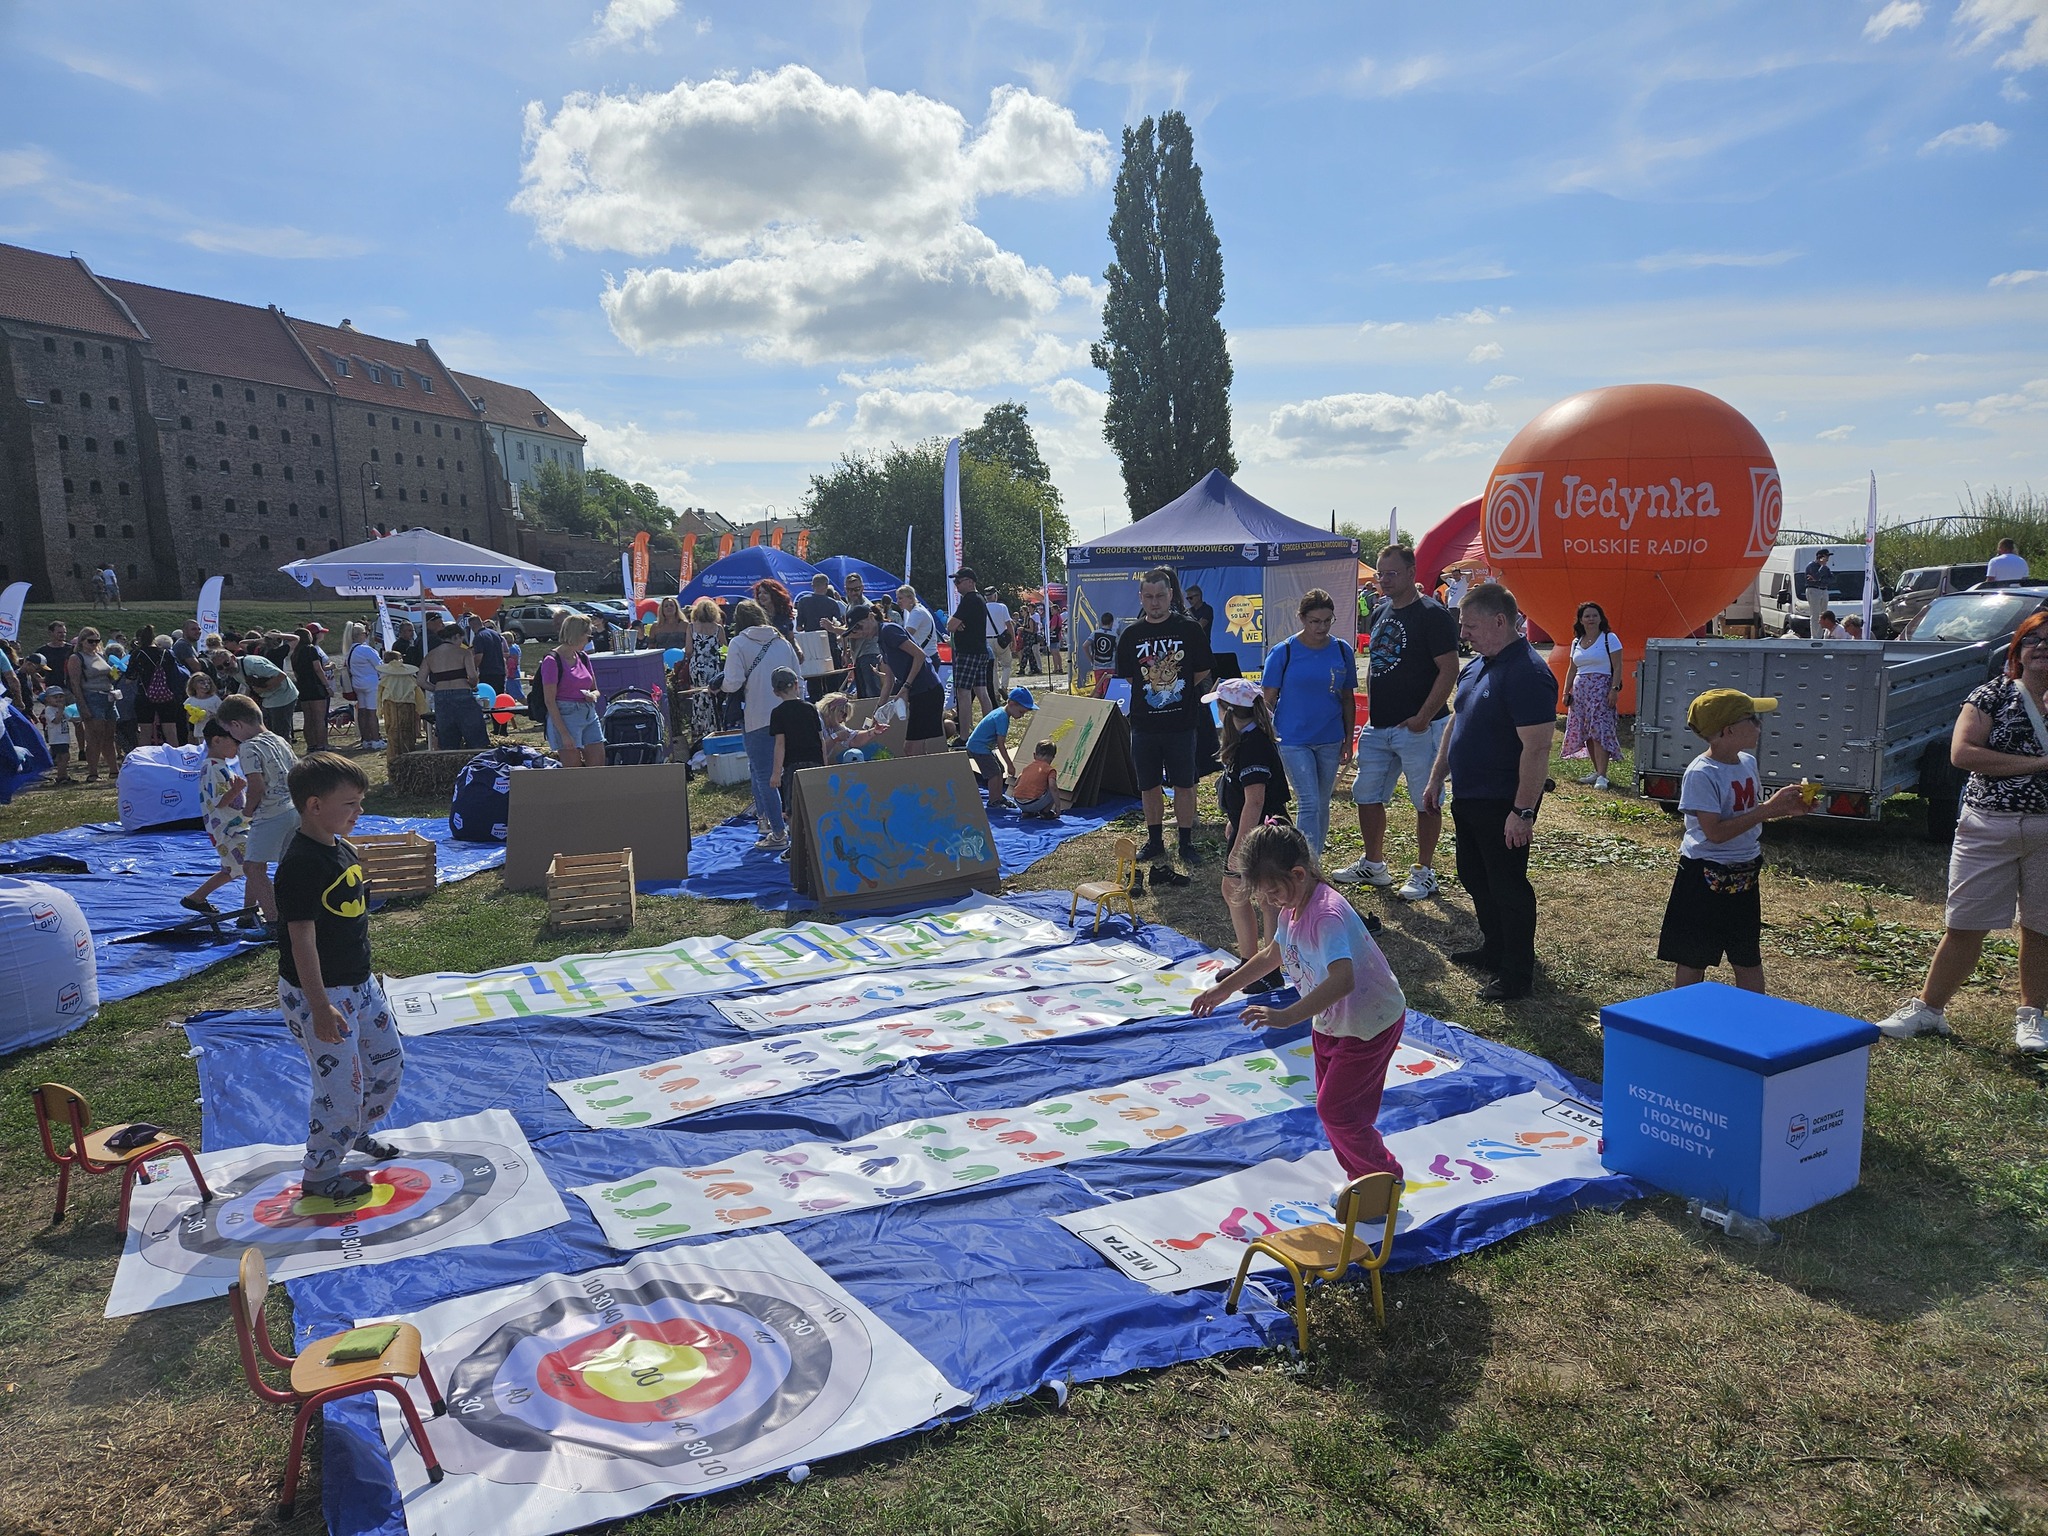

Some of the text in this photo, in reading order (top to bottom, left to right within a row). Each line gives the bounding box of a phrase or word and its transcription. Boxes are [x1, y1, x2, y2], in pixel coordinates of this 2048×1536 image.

[1555, 475, 1720, 530] Jedynka
[1095, 544, 1235, 554] OŚRODEK SZKOLENIA ZAWODOWEGO
[1563, 538, 1708, 555] POLSKIE RADIO
[436, 573, 501, 586] www.ohp.pl
[1246, 632, 1259, 641] WE
[1100, 640, 1107, 651] 9
[1731, 777, 1755, 812] M
[40, 916, 58, 930] OHP
[62, 998, 80, 1012] OHP
[1629, 1084, 1729, 1129] KSZTAŁCENIE
[1558, 1109, 1603, 1130] ART
[1644, 1107, 1711, 1140] I ROZWÓJ
[1813, 1109, 1844, 1125] OCHOTNICZE
[1812, 1119, 1844, 1135] HUFCE PRACY
[1640, 1122, 1715, 1159] OSOBISTY
[1790, 1132, 1806, 1143] OHP
[1800, 1148, 1828, 1163] www.ohp.pl
[503, 1161, 520, 1171] 10
[188, 1218, 207, 1233] 30
[226, 1212, 244, 1225] 40
[340, 1225, 359, 1237] 40
[341, 1238, 362, 1249] 30
[343, 1249, 363, 1260] 10
[1102, 1235, 1158, 1272] META
[582, 1279, 605, 1295] 10
[591, 1292, 615, 1311] 30
[602, 1308, 624, 1325] 40
[822, 1307, 848, 1323] 10
[789, 1319, 815, 1336] 30
[753, 1330, 776, 1344] 40
[505, 1387, 534, 1405] 40
[458, 1396, 485, 1415] 30
[671, 1421, 698, 1437] 40
[683, 1440, 713, 1457] 30
[697, 1459, 728, 1476] 10
